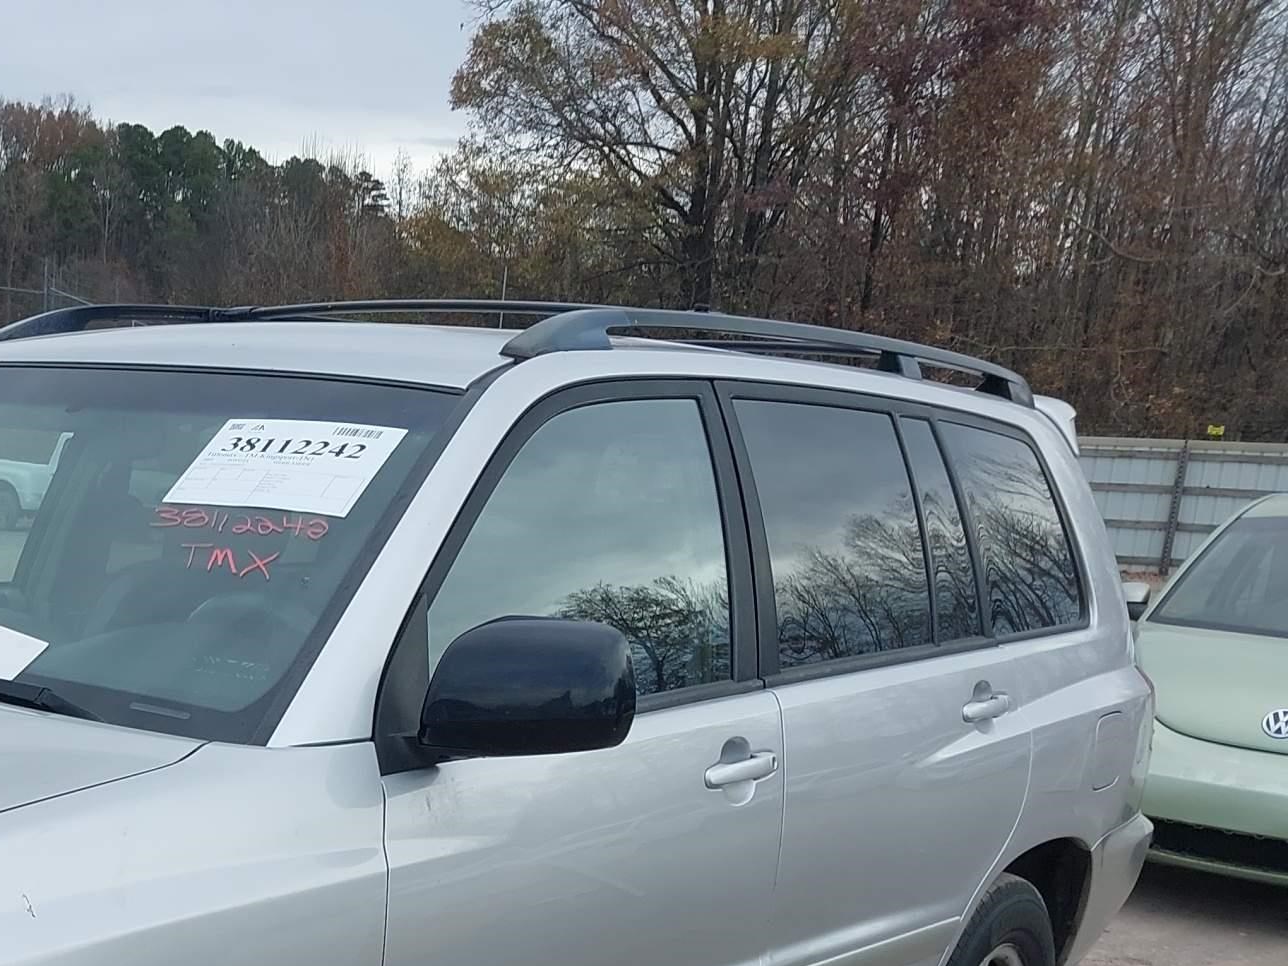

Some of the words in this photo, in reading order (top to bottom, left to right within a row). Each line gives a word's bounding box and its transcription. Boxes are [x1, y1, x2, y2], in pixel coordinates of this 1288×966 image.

[220, 436, 367, 459] 38112242
[150, 507, 329, 540] 38112242
[182, 543, 280, 580] TMX
